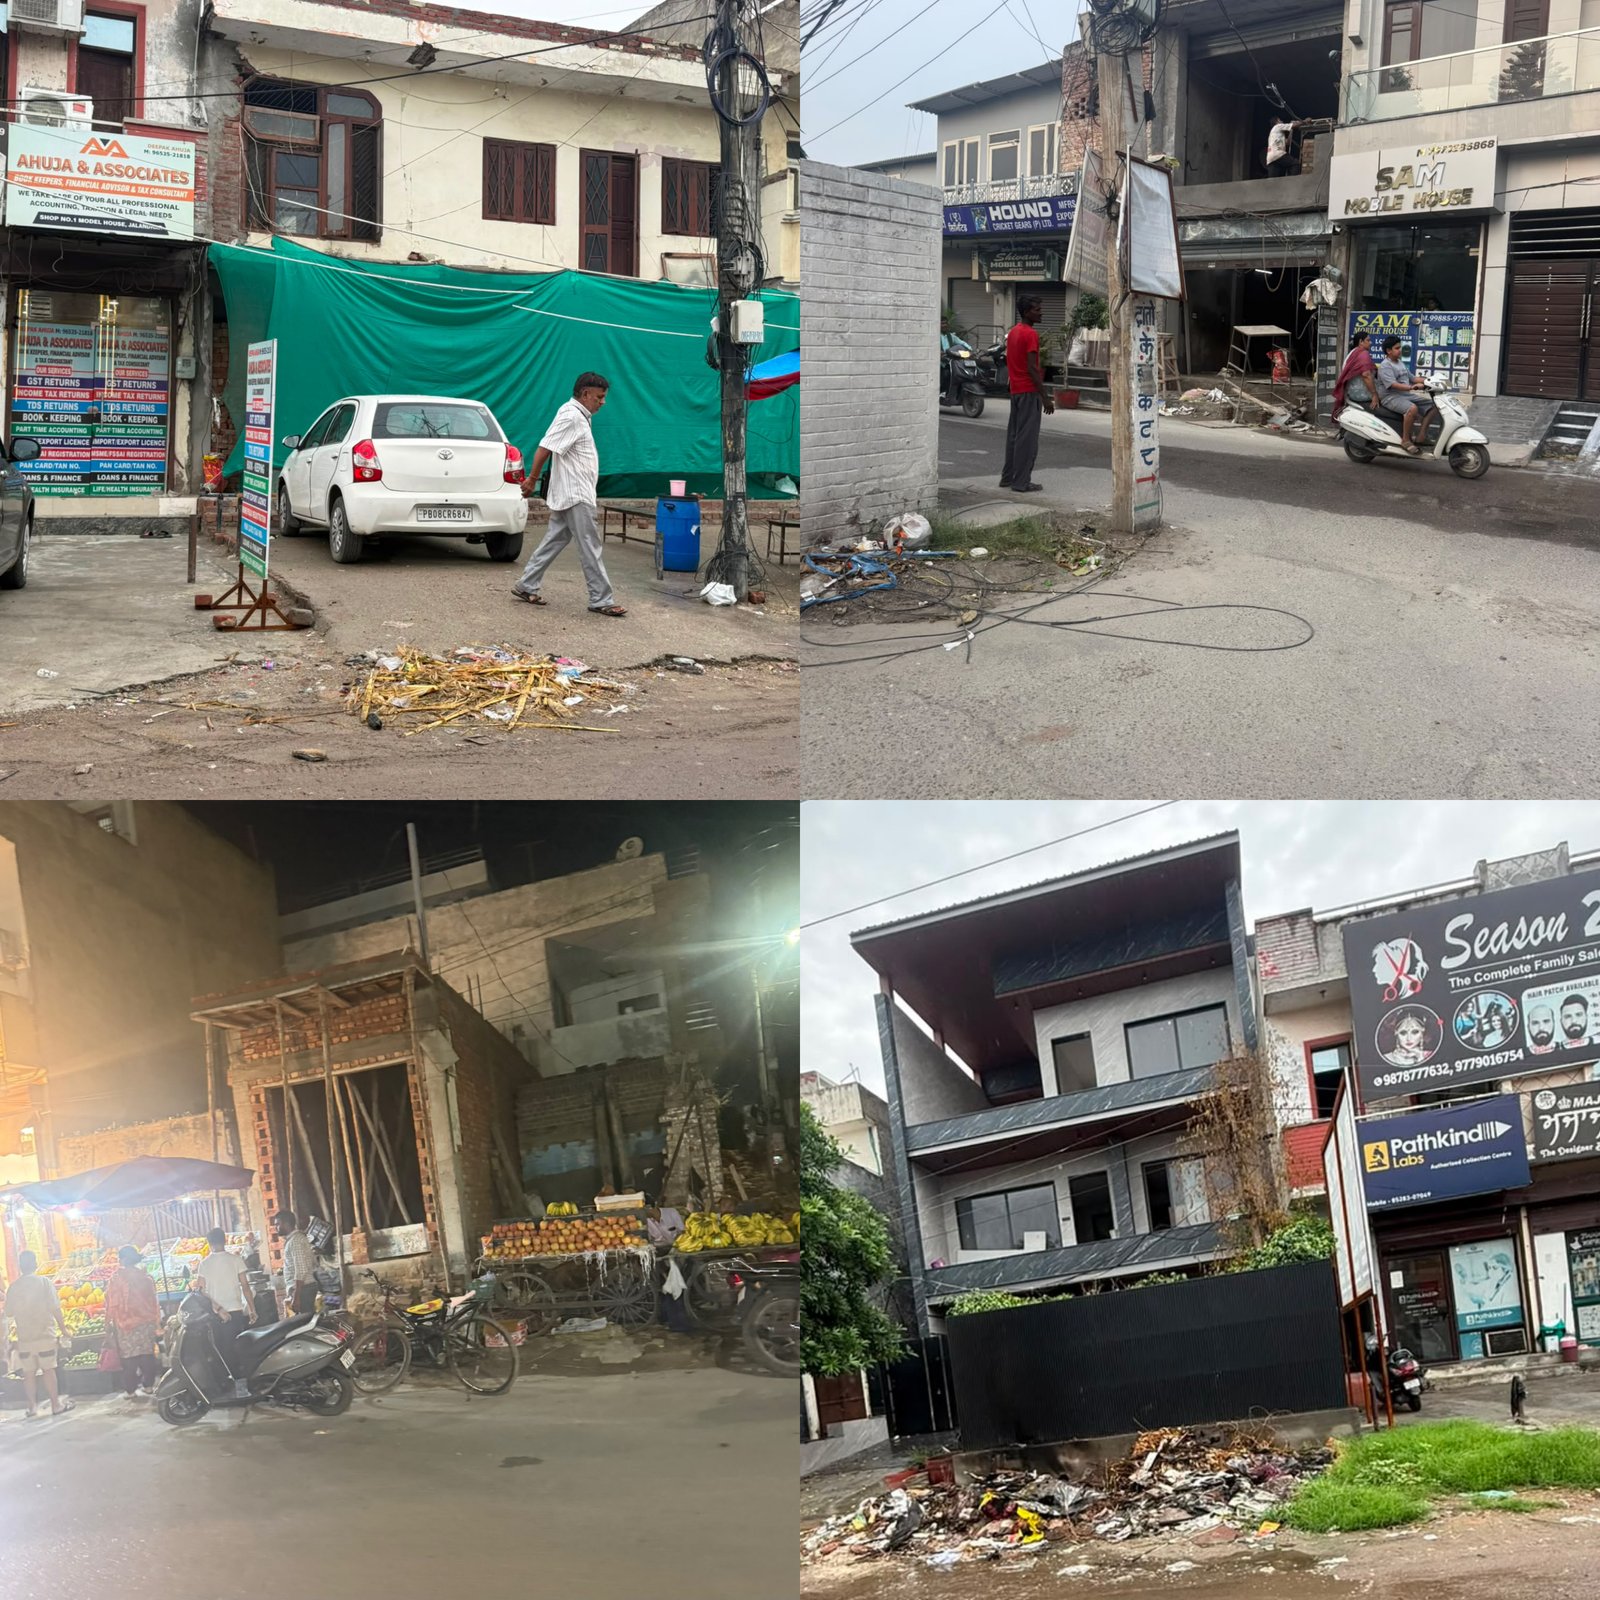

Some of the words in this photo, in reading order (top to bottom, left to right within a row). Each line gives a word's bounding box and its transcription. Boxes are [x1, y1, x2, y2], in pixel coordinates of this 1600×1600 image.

[17, 154, 73, 174] AHUJA
[77, 160, 90, 175] &
[93, 162, 189, 186] ASSOCIATES
[1375, 161, 1447, 192] SAM
[65, 178, 100, 190] FINANCIAL
[101, 182, 130, 192] ADVISOR
[137, 185, 150, 194] TAX
[150, 186, 189, 198] CONSULTANT
[32, 191, 51, 199] TAKE
[85, 196, 105, 204] YOUR
[106, 198, 121, 206] ALL
[122, 199, 180, 212] PROFESSIONAL
[1344, 194, 1405, 215] MOBILE
[1413, 187, 1474, 209] HOUSE
[30, 200, 80, 212] ACCOUNTING,
[125, 208, 148, 217] LEGAL
[149, 210, 173, 219] NEEDS
[988, 201, 1053, 221] HOUND
[40, 214, 59, 222] SHOP
[78, 217, 101, 226] MODEL
[103, 220, 127, 229] HOUSE,
[992, 221, 1014, 231] CRICKET
[1014, 220, 1032, 230] GEARS
[1033, 219, 1042, 229] (P)
[1042, 218, 1054, 228] LTD.
[993, 251, 1040, 262] Shivam
[990, 260, 1023, 268] MOBILE
[1025, 260, 1044, 268] HUB
[1355, 313, 1412, 328] SAM
[1382, 327, 1409, 335] HOUSE
[50, 337, 93, 350] ASSOCIATES
[128, 340, 169, 353] ASSOCIATES
[36, 366, 46, 374] OUR
[46, 367, 71, 375] SERVICES
[125, 369, 149, 378] SERVICES
[27, 377, 42, 386] GST
[44, 378, 80, 388] RETURNS
[107, 380, 121, 388] GST
[123, 381, 157, 389] RETURNS
[45, 391, 56, 399] TAX
[57, 391, 90, 400] RETURNS
[122, 393, 133, 401] TAX
[134, 393, 166, 402] RETURNS
[27, 401, 42, 410] TDS
[44, 402, 79, 411] RETURNS
[105, 403, 119, 411] TDS
[122, 404, 156, 413] RETURNS
[22, 413, 43, 421] BOOK
[50, 414, 82, 423] KEEPING
[103, 414, 123, 423] BOOK
[128, 416, 158, 425] KEEPING
[112, 427, 125, 435] TIME
[141, 439, 165, 447] LICENCE
[48, 450, 90, 459] REGISTRATION
[127, 451, 165, 459] REGISTRATION
[20, 462, 33, 470] PAN
[34, 462, 68, 470] CARD/TAN
[100, 462, 112, 470] PAN
[113, 462, 145, 470] CARD/TAN
[22, 474, 42, 482] OANS
[50, 475, 82, 483] FINANCE
[97, 474, 120, 482] LOANS
[51, 486, 86, 495] INSURANCE
[92, 486, 128, 494] LIFE/HEALTH
[129, 486, 161, 494] INSURANCE
[423, 509, 471, 519] PB08CR6847
[1440, 911, 1569, 969] Season
[1448, 976, 1471, 989] The
[1473, 963, 1532, 981] Complete
[1534, 955, 1576, 971] Family
[1527, 990, 1543, 999] HAIR
[1544, 986, 1565, 996] PATCH
[1565, 978, 1600, 991] AVAILABLE
[1454, 1048, 1525, 1072] 9779016754
[1390, 1122, 1483, 1156] Pathkind
[1557, 1144, 1594, 1157] Designer
[1392, 1153, 1425, 1168] Labs
[1462, 1154, 1491, 1165] Collection
[1491, 1150, 1512, 1161] Centre
[1366, 1199, 1387, 1208] Mobile
